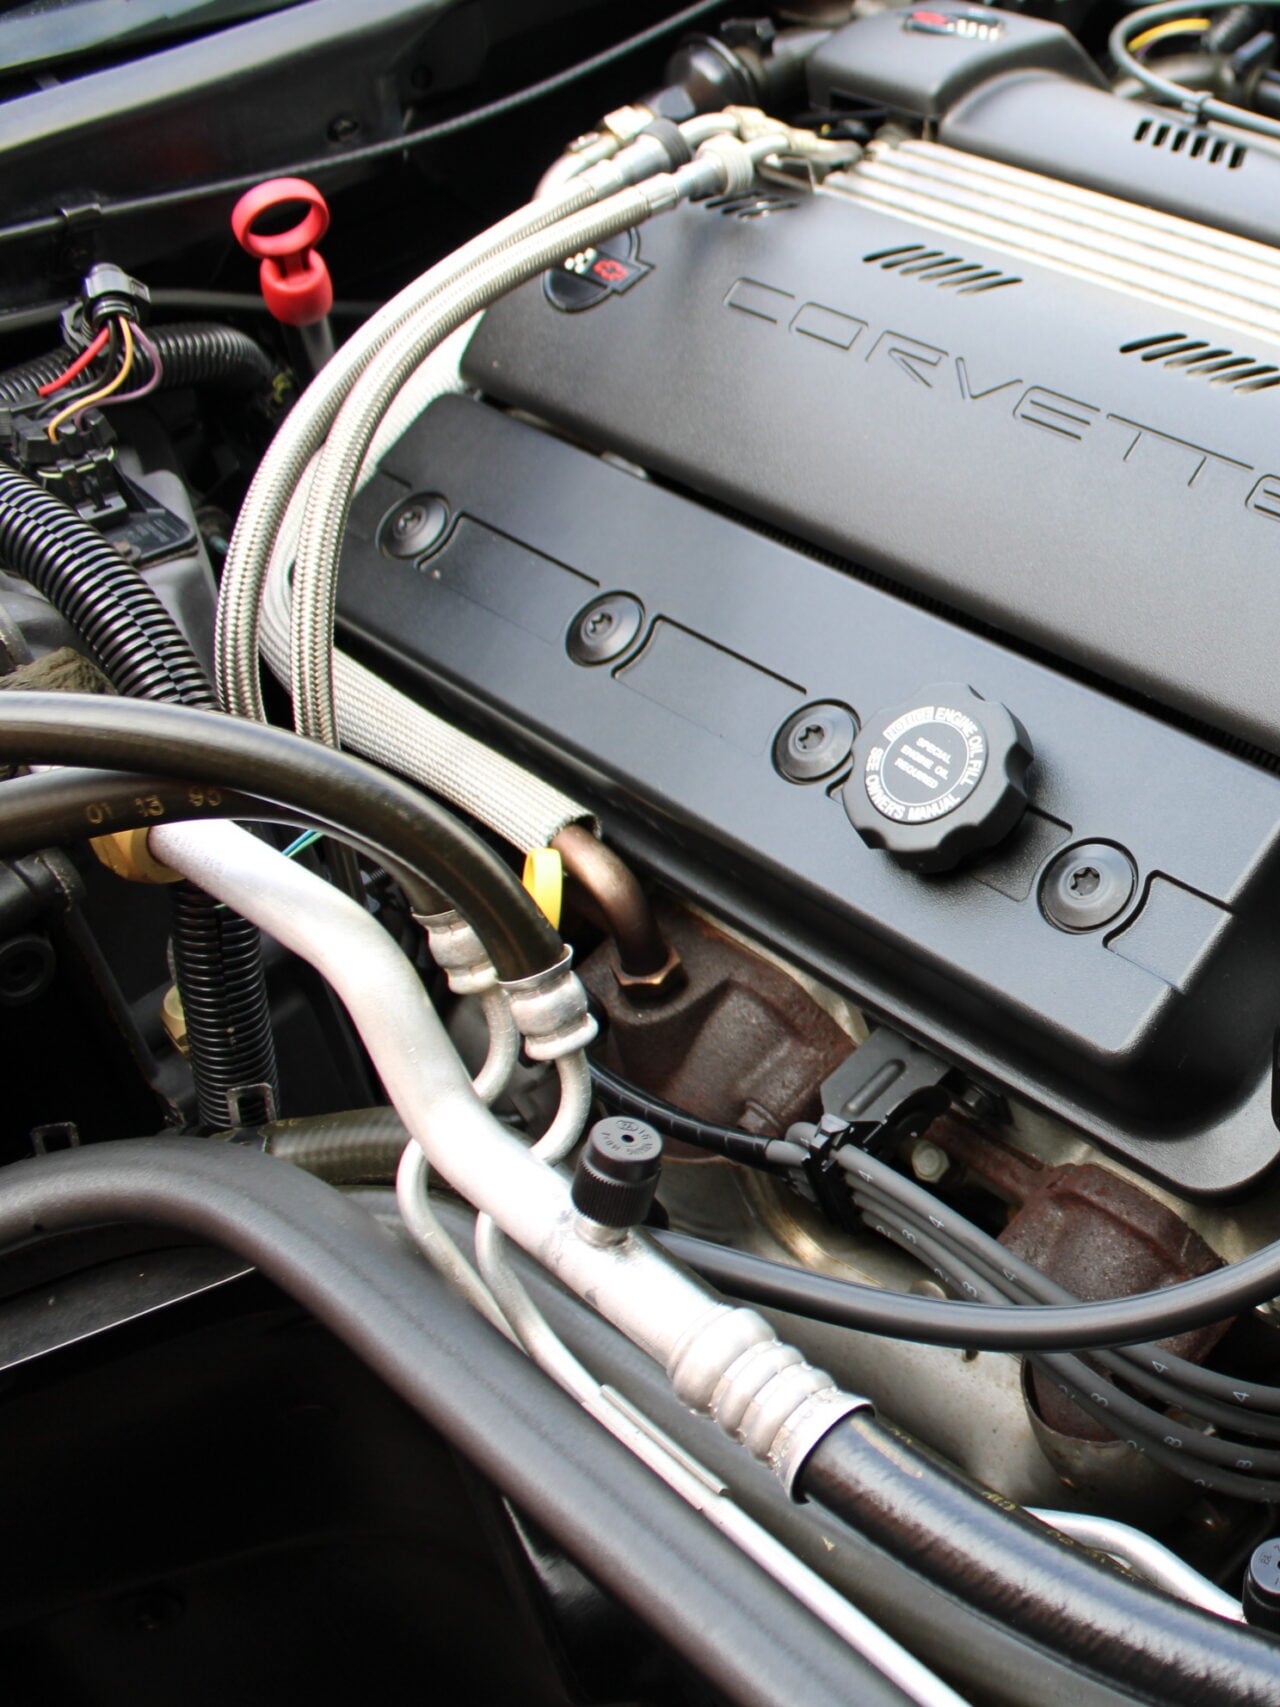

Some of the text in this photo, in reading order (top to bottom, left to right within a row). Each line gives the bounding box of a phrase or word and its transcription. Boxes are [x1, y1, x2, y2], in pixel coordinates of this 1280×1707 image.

[900, 744, 949, 780] ENGINE OIL
[916, 737, 952, 764] SPECIAL
[935, 707, 985, 786] ENGINE OIL FILL
[865, 747, 884, 772] SEE
[907, 793, 961, 821] MANUAL
[894, 757, 939, 789] REQUIRED
